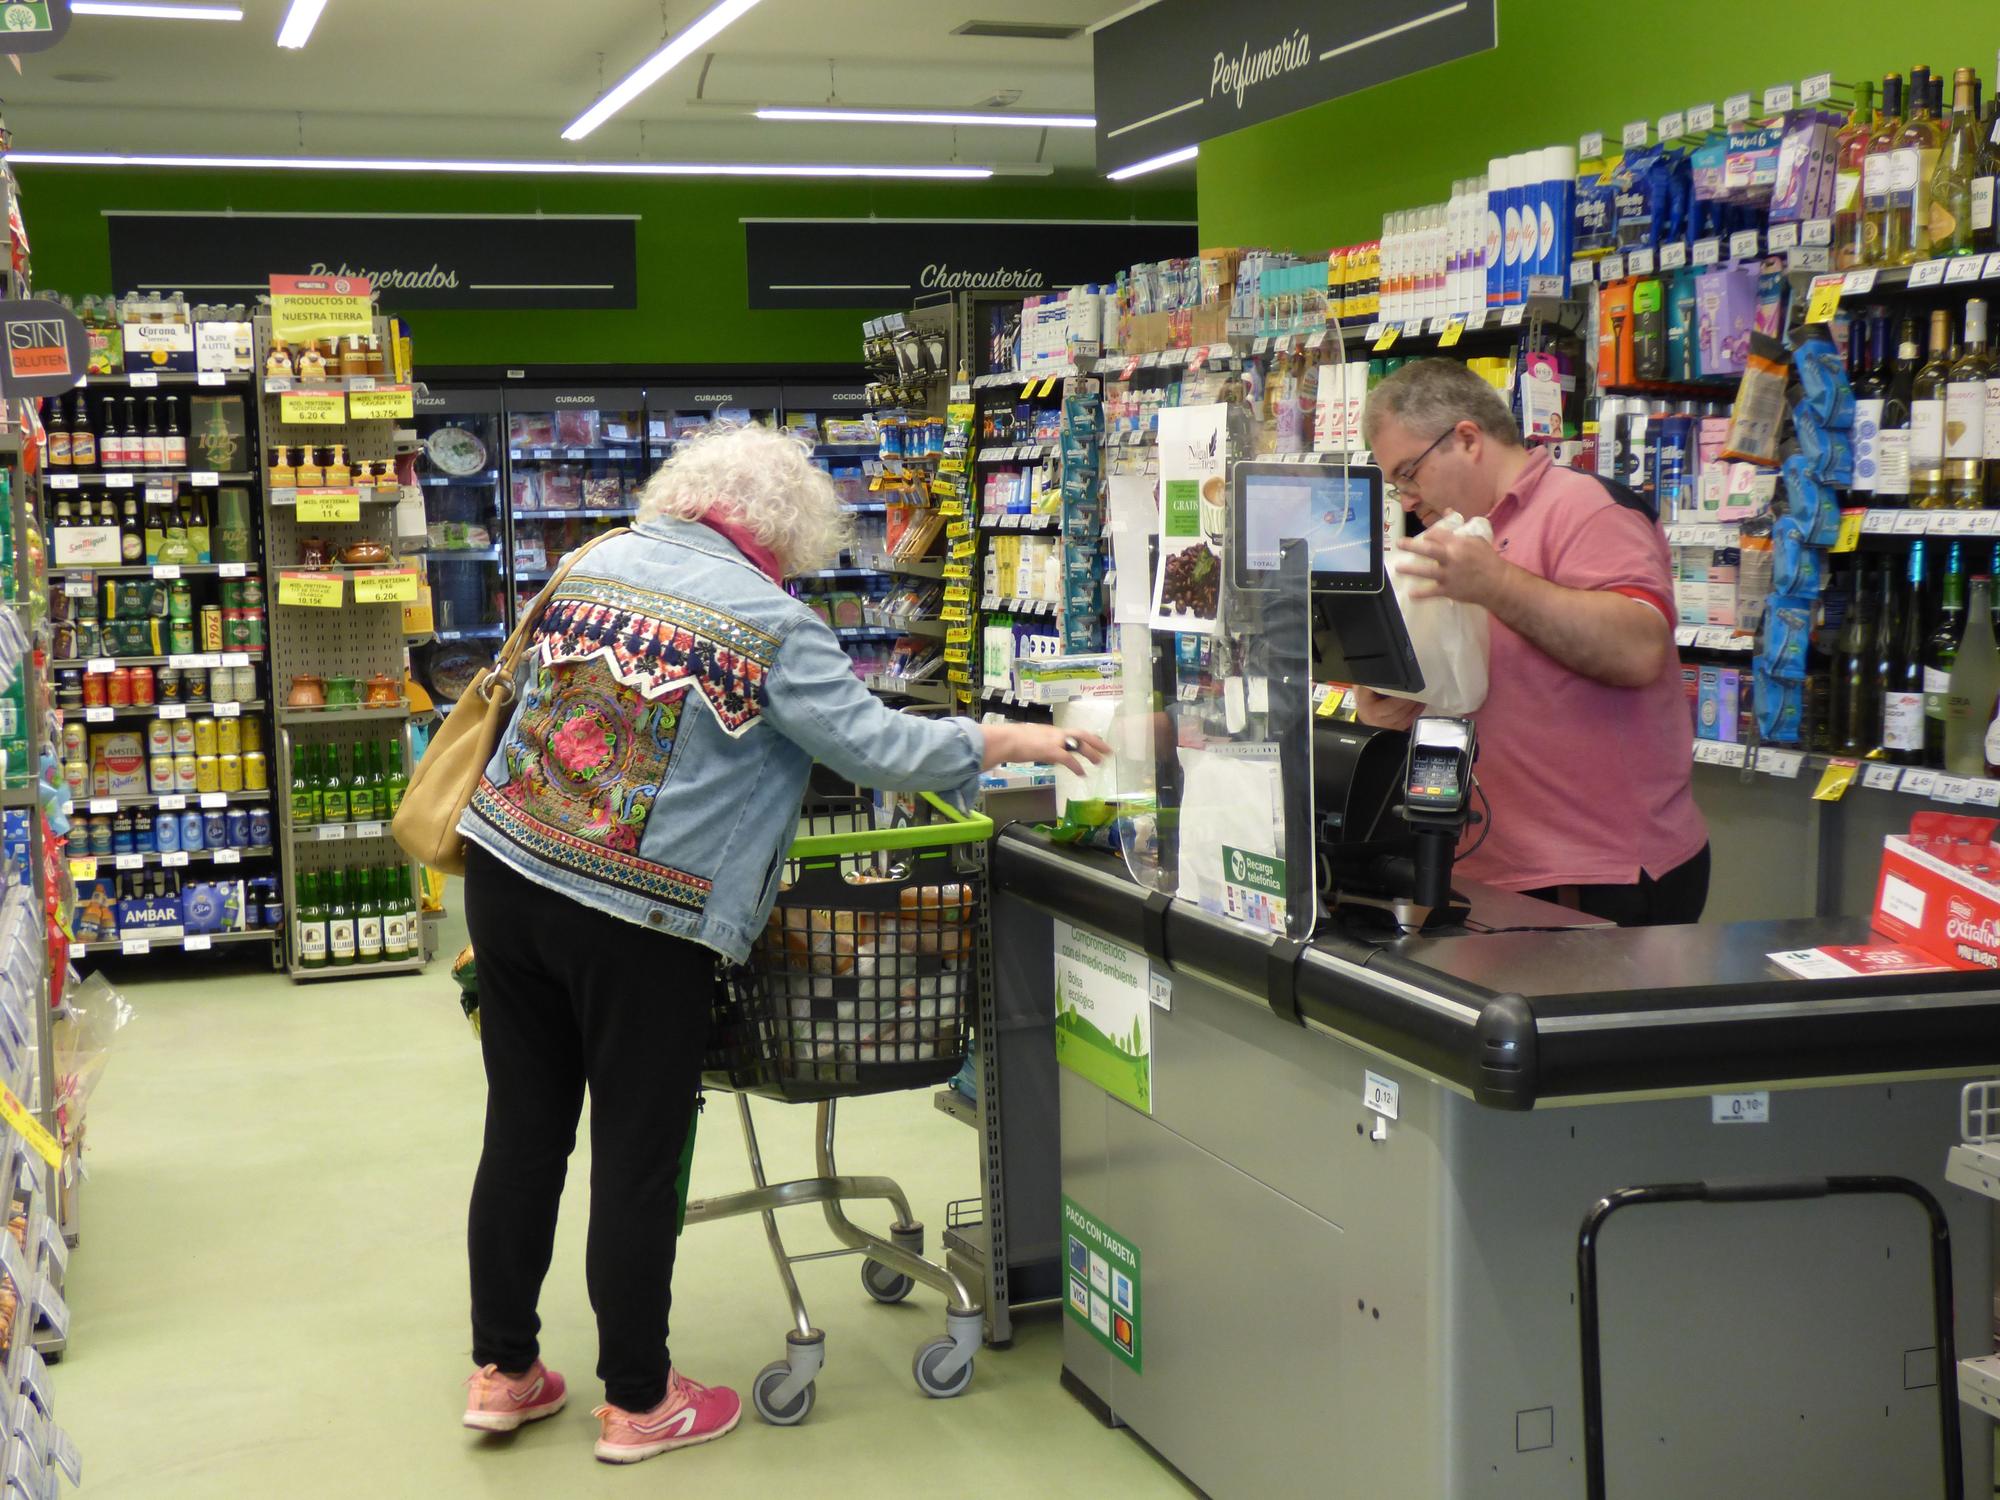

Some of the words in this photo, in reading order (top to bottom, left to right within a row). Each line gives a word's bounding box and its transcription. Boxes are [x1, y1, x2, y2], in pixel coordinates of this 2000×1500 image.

[1210, 28, 1310, 109] Perfumería
[920, 264, 1044, 289] Charcutería
[284, 297, 343, 305] PRODUCTOS
[346, 297, 358, 305] DE
[282, 312, 327, 321] NUESTRA
[329, 312, 363, 321] TIERRA
[12, 322, 62, 348] SIN
[139, 327, 176, 337] Corona
[13, 354, 67, 369] GLUTEN
[555, 395, 595, 404] CURADOS
[694, 394, 733, 402] CURADOS
[299, 411, 318, 420] 6.20
[370, 409, 399, 418] 13.75€
[321, 510, 332, 518] 11
[335, 510, 341, 518] €
[375, 592, 398, 601] 6.20€
[1246, 857, 1273, 876] Recarga
[1247, 871, 1281, 890] telefónica
[125, 908, 178, 924] AMBAR
[1071, 927, 1127, 963] Comprometidos
[1062, 946, 1075, 959] con
[1081, 951, 1103, 972] medio
[1103, 961, 1138, 989] ambiente
[1067, 970, 1083, 988] Bolsa
[1068, 990, 1095, 1010] ecológica
[1066, 1205, 1085, 1230] PAGO
[1085, 1220, 1102, 1245] CON
[1102, 1232, 1136, 1268] TARJETA
